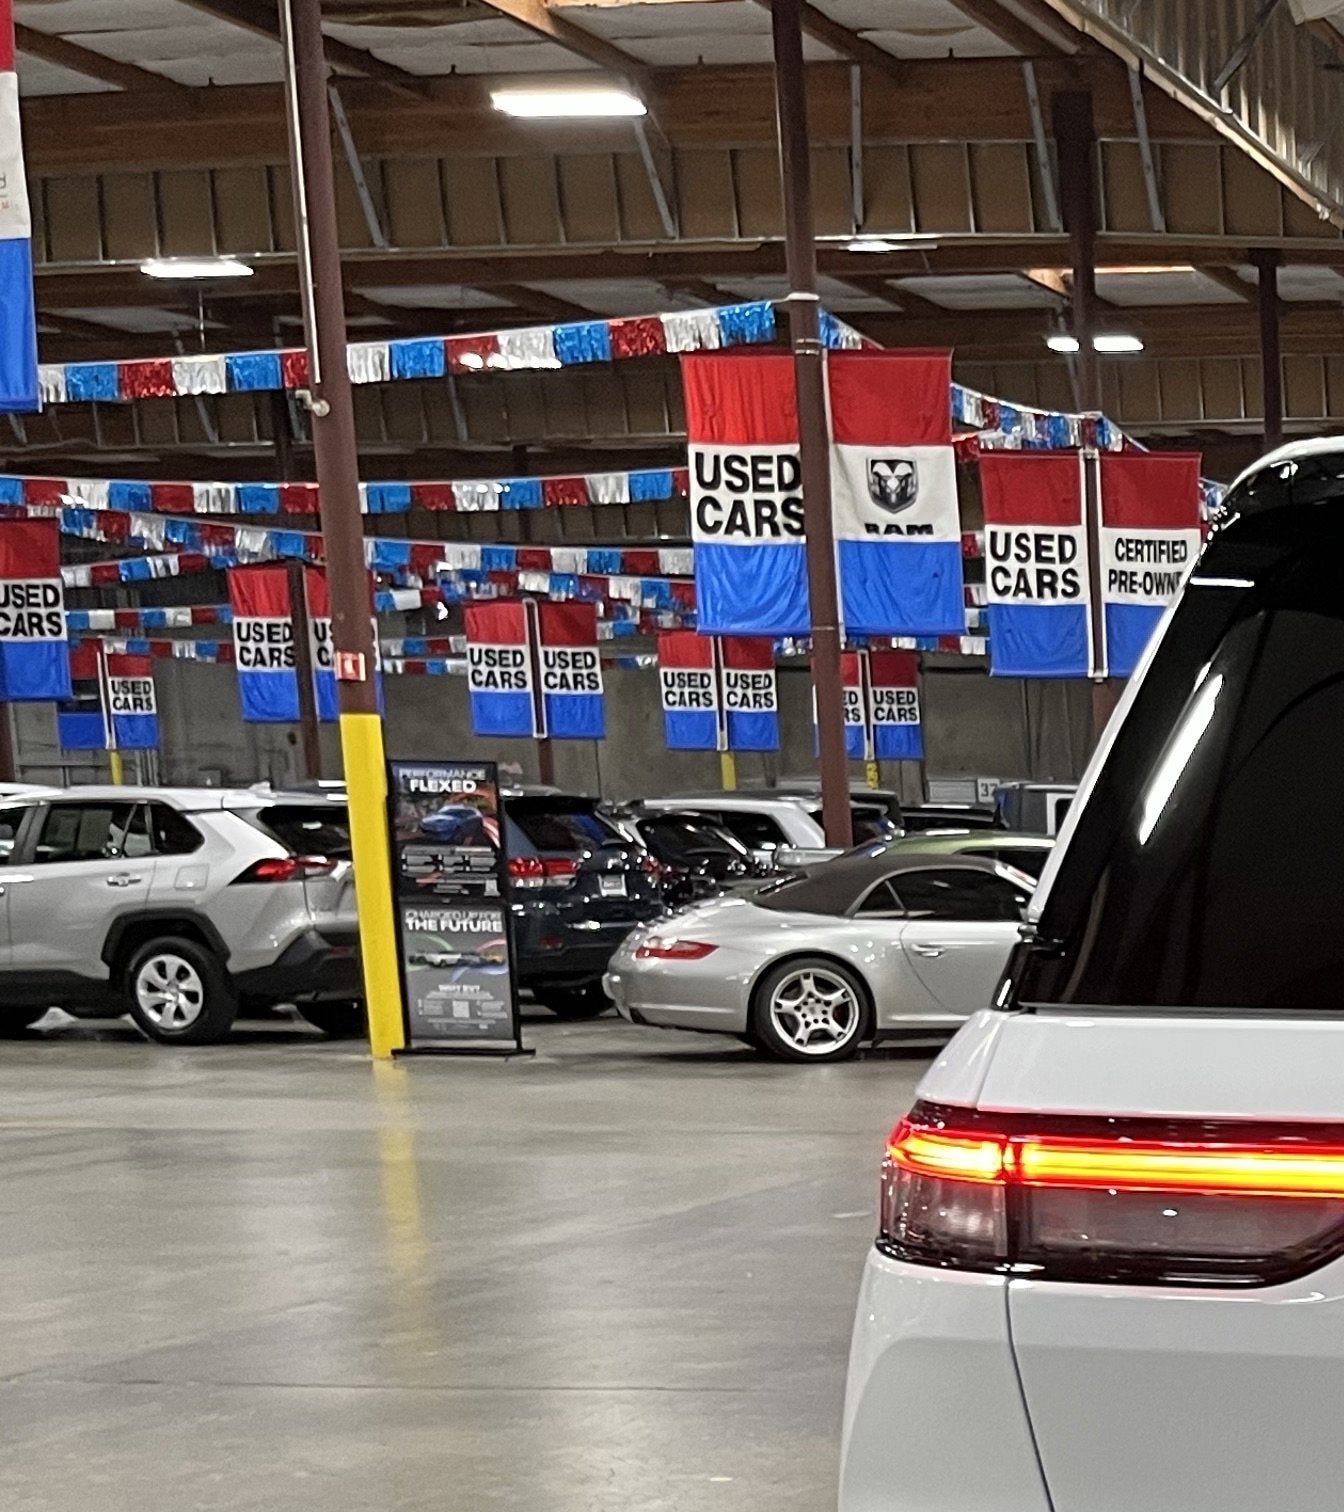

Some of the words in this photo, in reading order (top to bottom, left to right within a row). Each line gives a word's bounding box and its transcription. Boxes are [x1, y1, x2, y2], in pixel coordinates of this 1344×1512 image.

[695, 452, 801, 494] USED
[696, 496, 805, 537] CARS
[864, 523, 934, 535] RAM
[990, 531, 1077, 564] USED
[1114, 537, 1188, 563] CERTIFIED
[990, 566, 1081, 599] CARS
[1108, 568, 1184, 595] PRE-OWN
[0, 612, 62, 636] CARS
[237, 622, 293, 643] USED
[239, 646, 296, 667] CARS
[469, 648, 525, 668] USED
[544, 650, 597, 669] USED
[111, 680, 152, 695] USED
[471, 669, 527, 689] CARS
[544, 671, 600, 690] CARS
[663, 671, 711, 689] USED
[726, 672, 773, 690] USED
[112, 697, 153, 711] CARS
[664, 690, 713, 707] CARS
[726, 691, 774, 708] CARS
[873, 690, 916, 705] USED
[874, 706, 918, 722] CARS
[410, 779, 477, 793] FLEXED
[406, 919, 438, 931] THE
[441, 920, 503, 932] FUTURE
